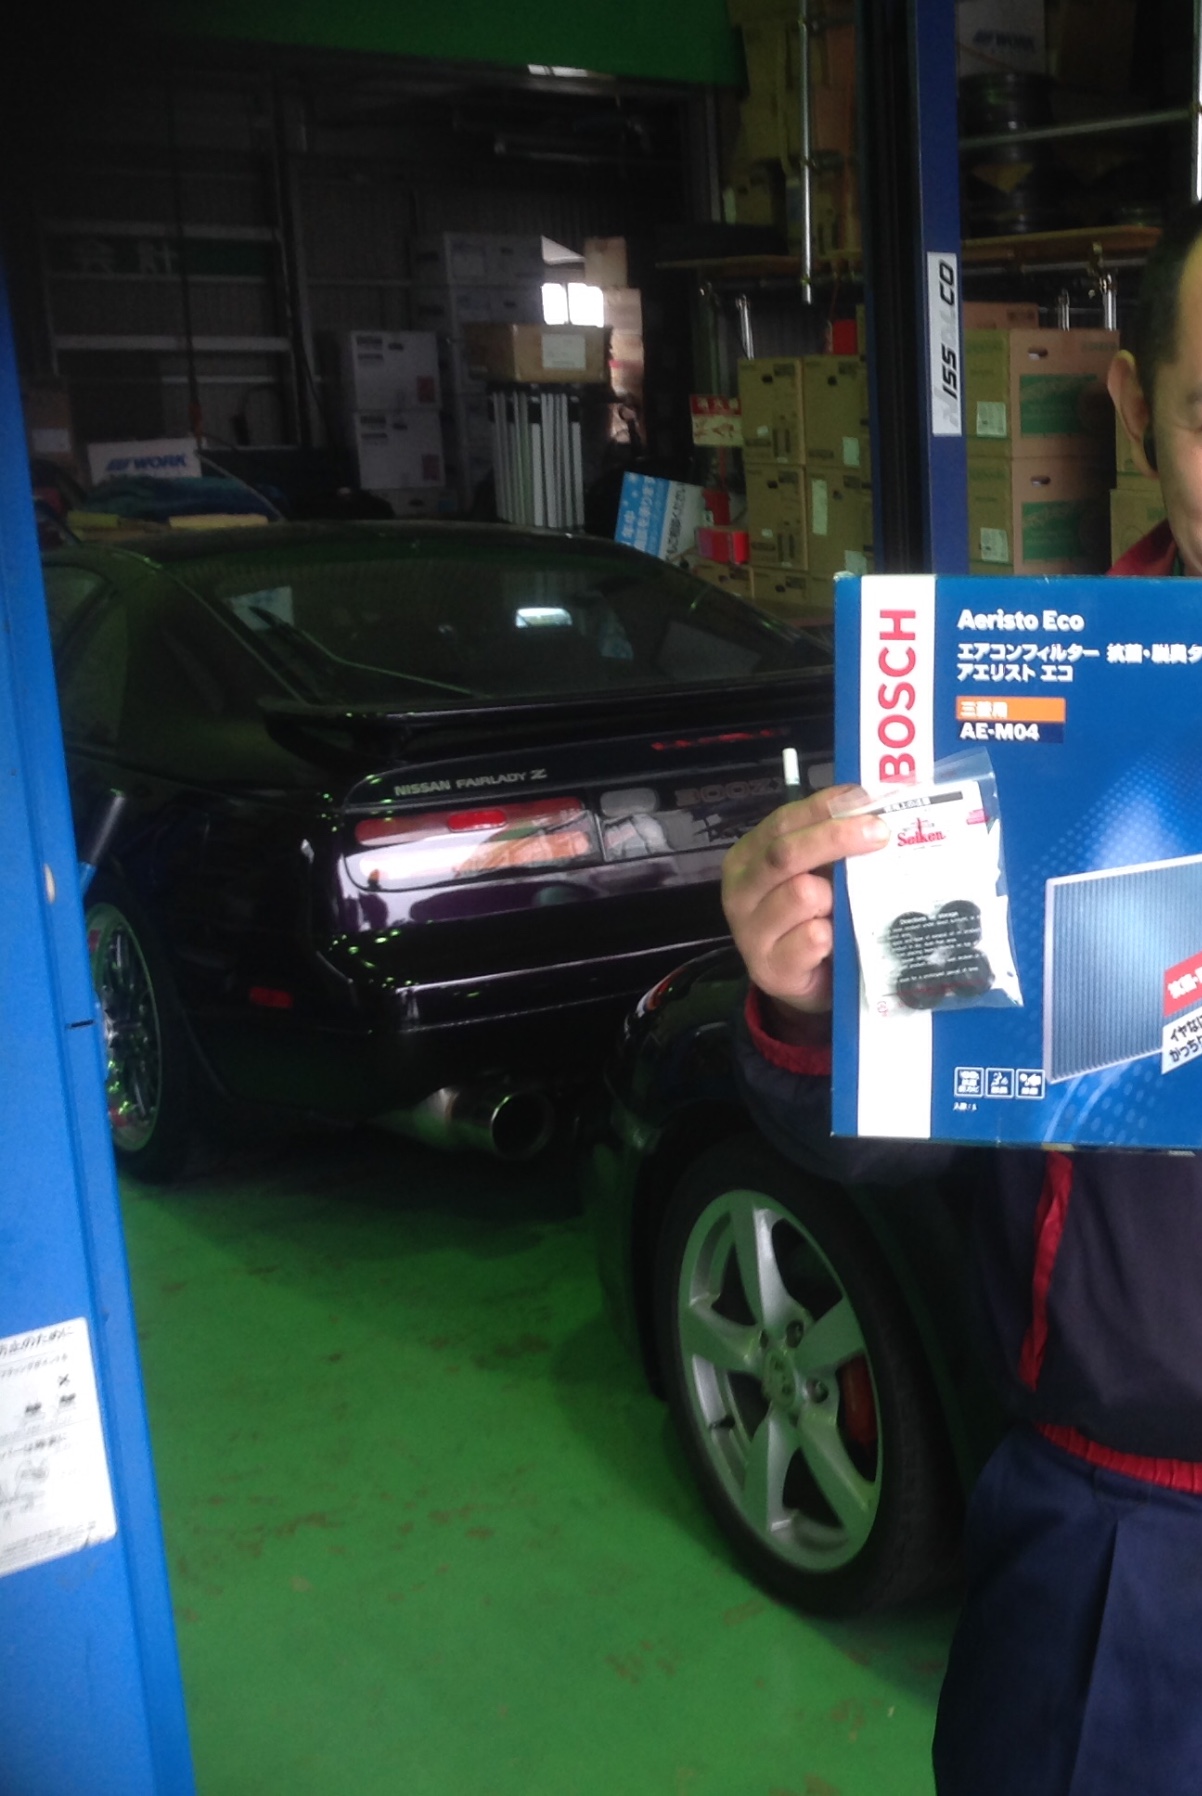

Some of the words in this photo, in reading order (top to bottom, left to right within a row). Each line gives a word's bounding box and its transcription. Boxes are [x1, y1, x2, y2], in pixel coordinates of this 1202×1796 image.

[134, 454, 187, 469] WORK
[957, 609, 1038, 631] Aeristo
[1042, 610, 1085, 631] Eco
[957, 642, 1100, 661] エアコンフィルター
[957, 663, 1036, 682] アエリスト
[1040, 664, 1073, 682] エコ
[878, 608, 917, 783] BOSCH
[960, 722, 1040, 741] AE-M04
[394, 779, 451, 796] NISSAN
[456, 771, 527, 789] FAIRLADY
[530, 768, 547, 781] Z
[897, 826, 946, 848] Seiken
